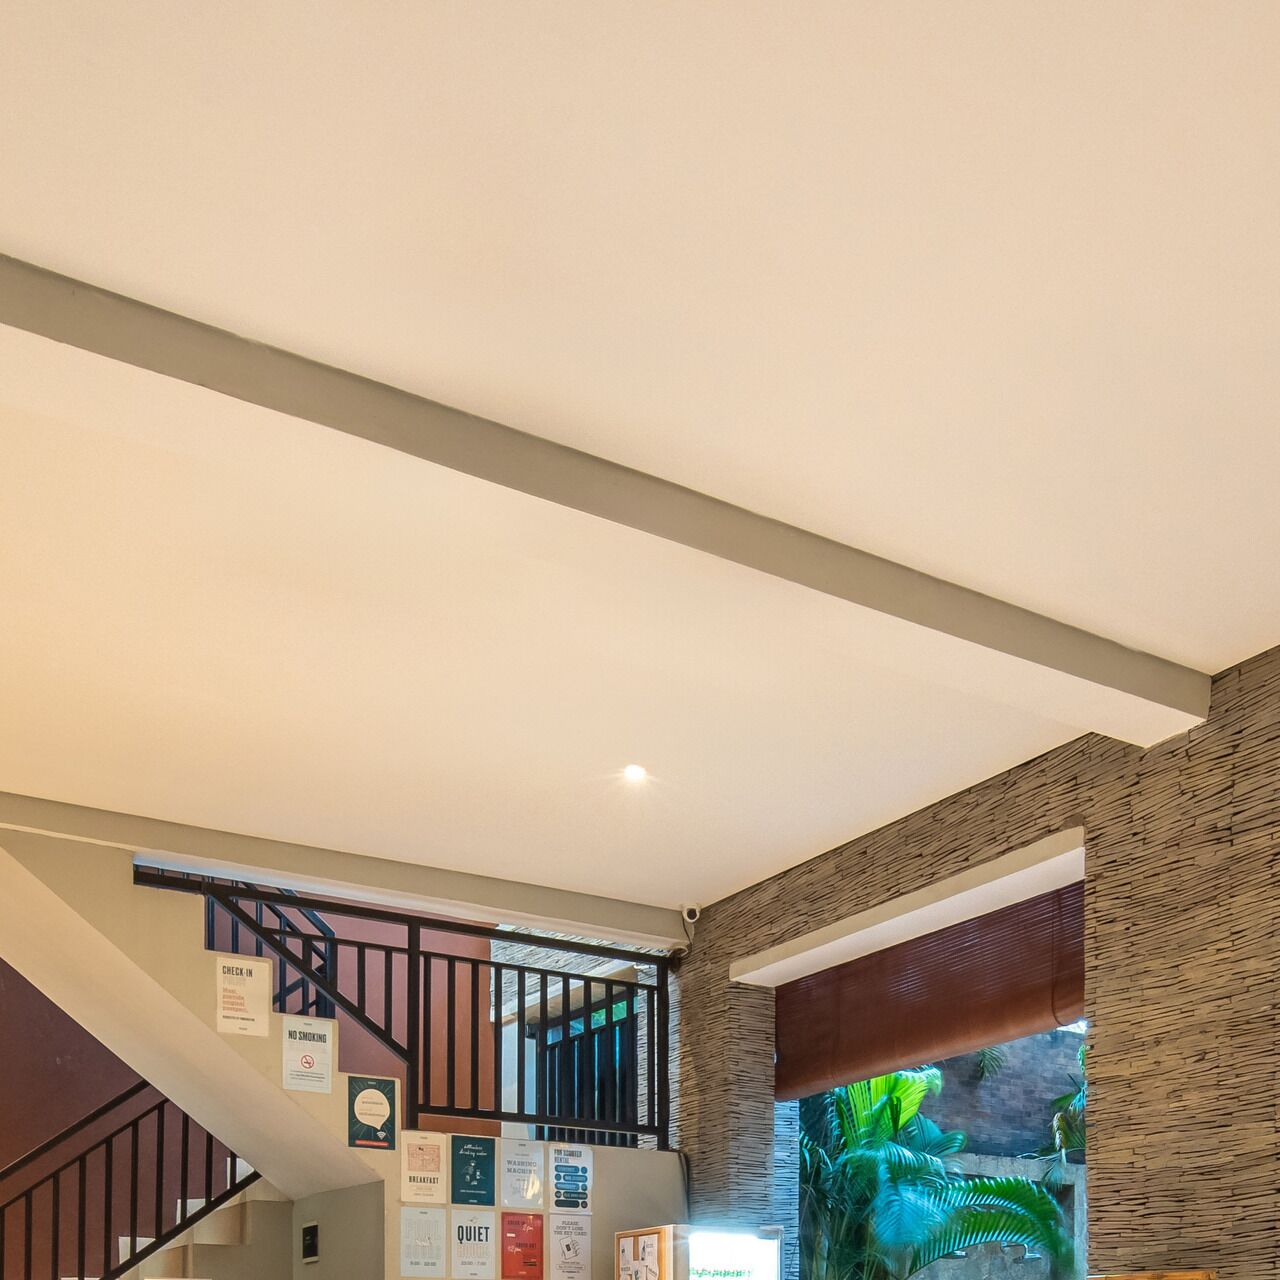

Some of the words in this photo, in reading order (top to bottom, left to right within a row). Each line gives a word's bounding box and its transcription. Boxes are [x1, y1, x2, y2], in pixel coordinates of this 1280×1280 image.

[288, 1030, 297, 1040] NO
[298, 1031, 327, 1043] SMOKING
[506, 1159, 537, 1167] WASHING
[506, 1167, 537, 1175] MACHINE
[408, 1175, 439, 1184] BREAKFAST
[457, 1225, 490, 1244] QUIET
